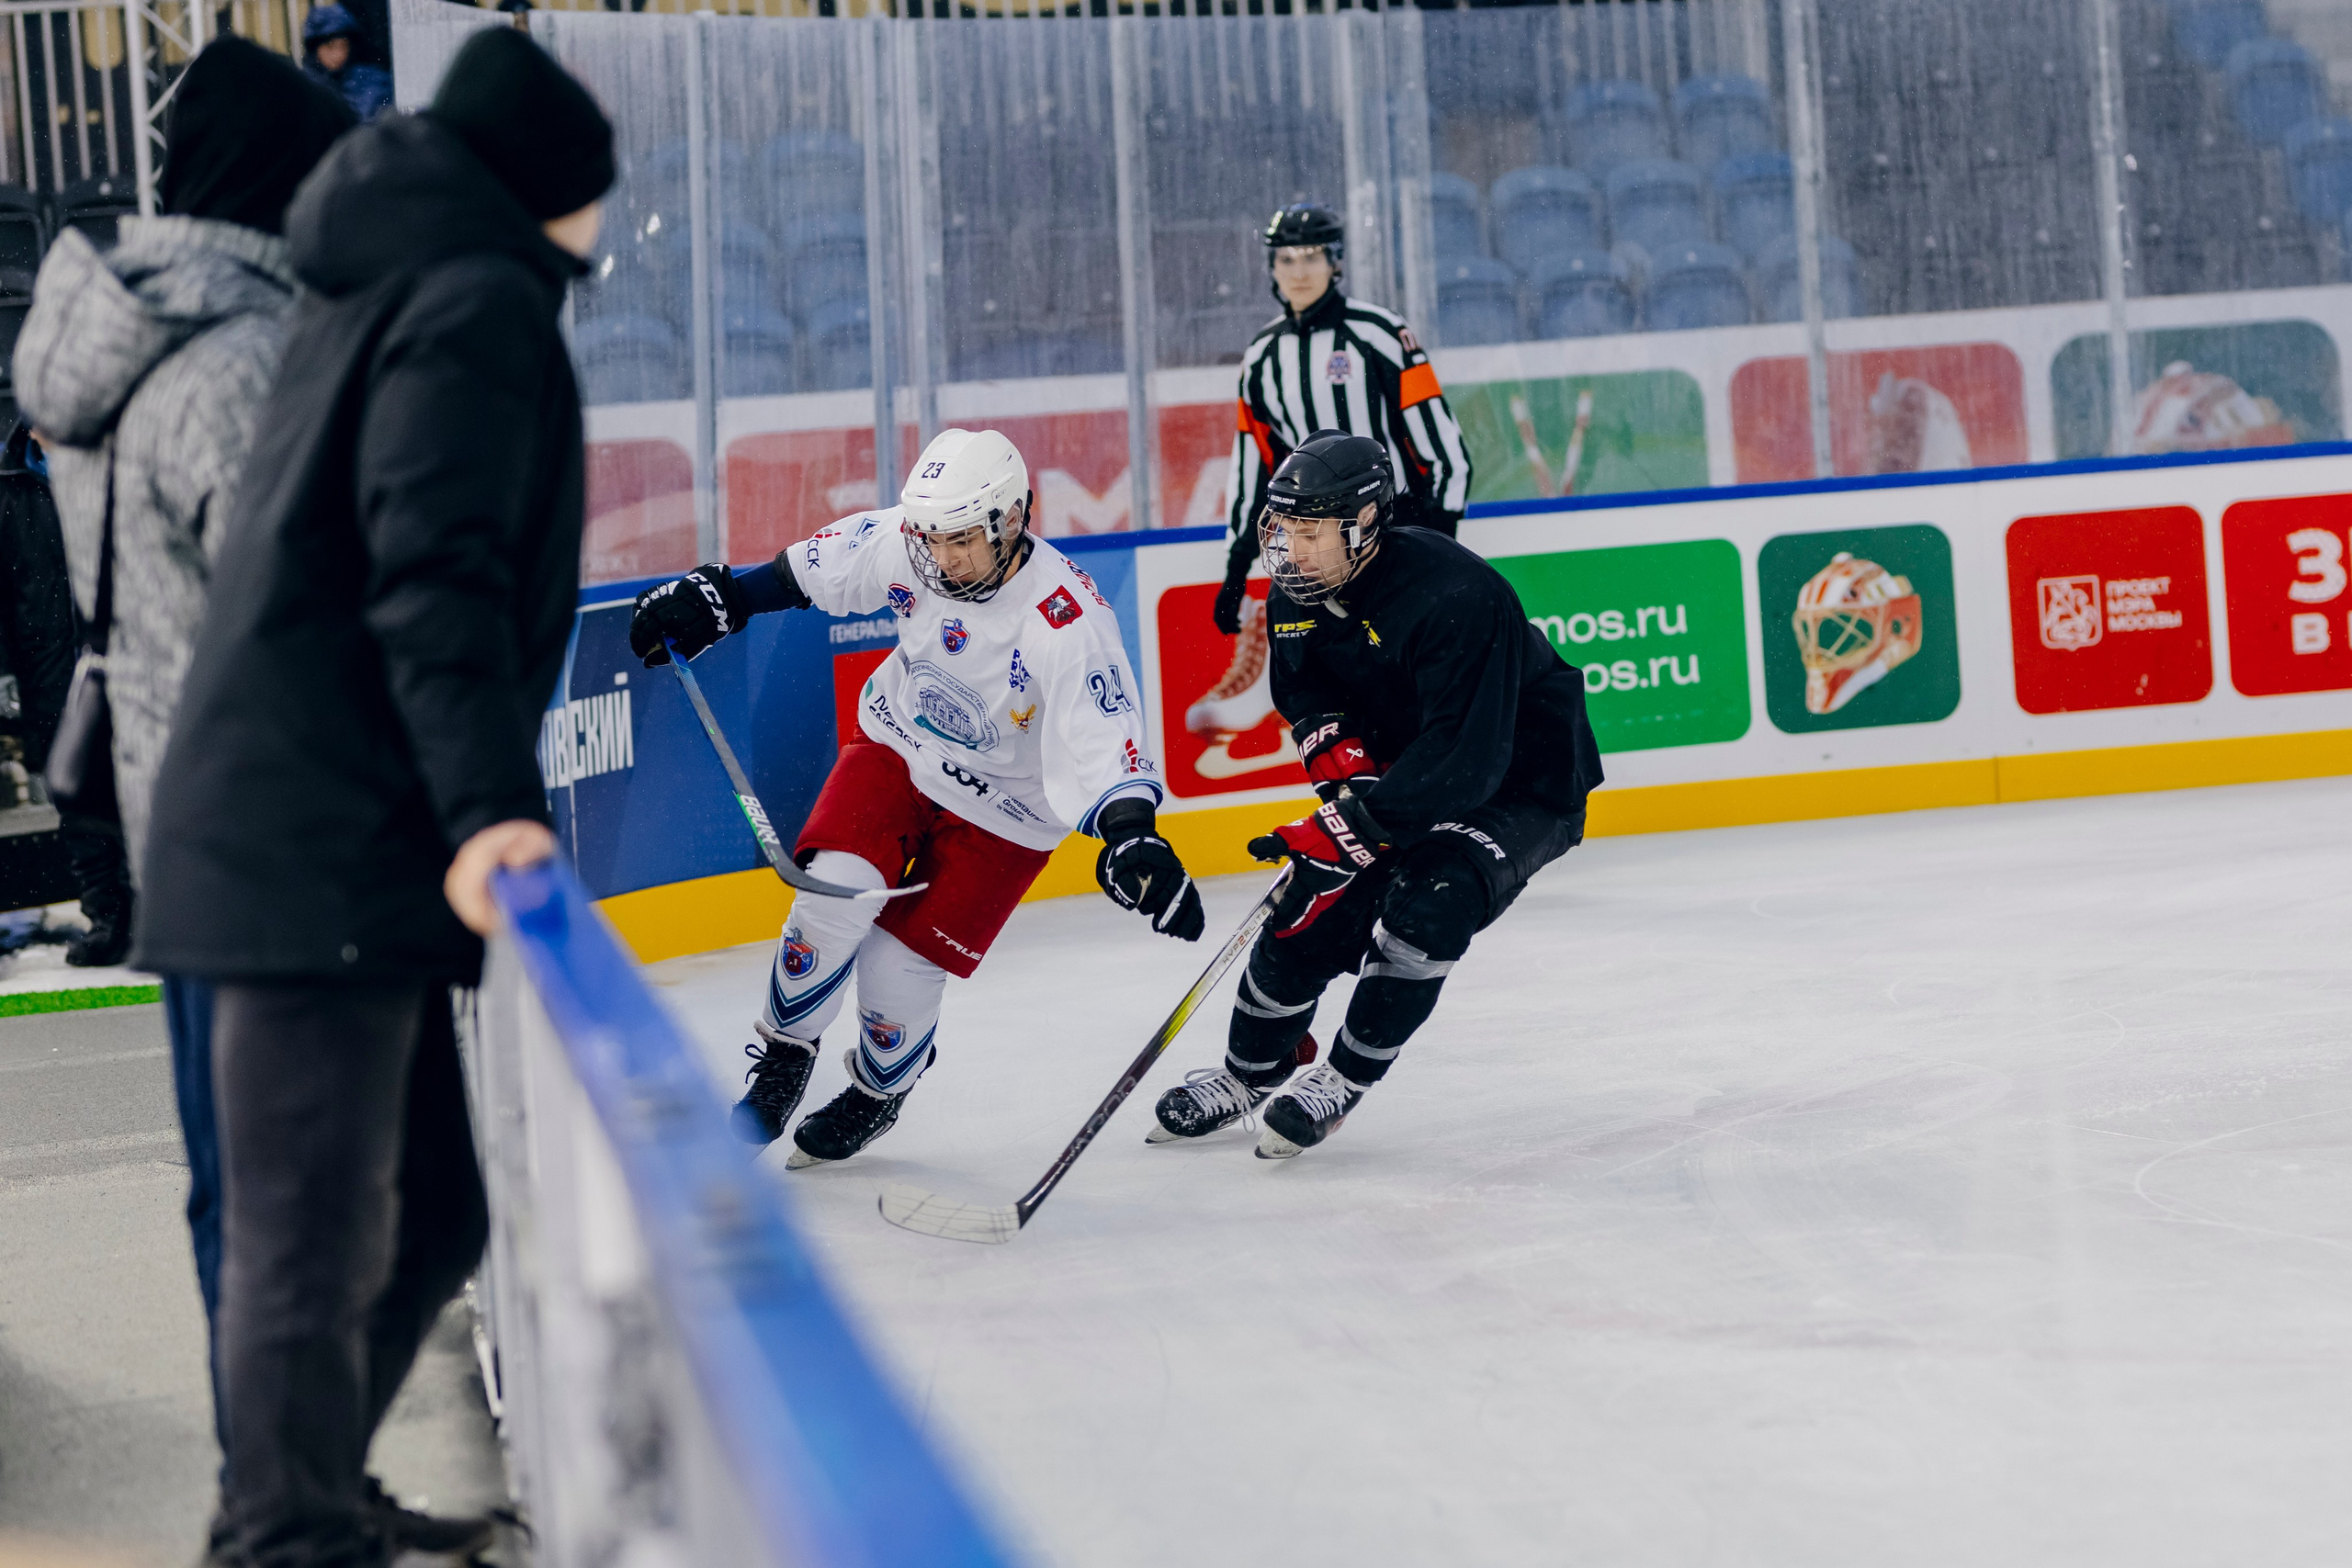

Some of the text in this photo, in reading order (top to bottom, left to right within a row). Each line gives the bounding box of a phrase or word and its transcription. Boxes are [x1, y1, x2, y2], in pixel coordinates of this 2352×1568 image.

[921, 462, 946, 479] 23
[1358, 480, 1381, 495] BAUER
[1270, 494, 1296, 506] BAUER
[685, 571, 729, 632] CCM
[2106, 576, 2172, 598] ПРОЕКТ
[2108, 609, 2183, 633] МОСКВЫ
[1583, 654, 1701, 694] os.ru
[542, 671, 634, 790] ОВСКИЙ
[1298, 721, 1340, 770] UER
[1317, 801, 1376, 869] BAUER
[1430, 822, 1507, 860] AUER
[933, 926, 983, 962] TRUE
